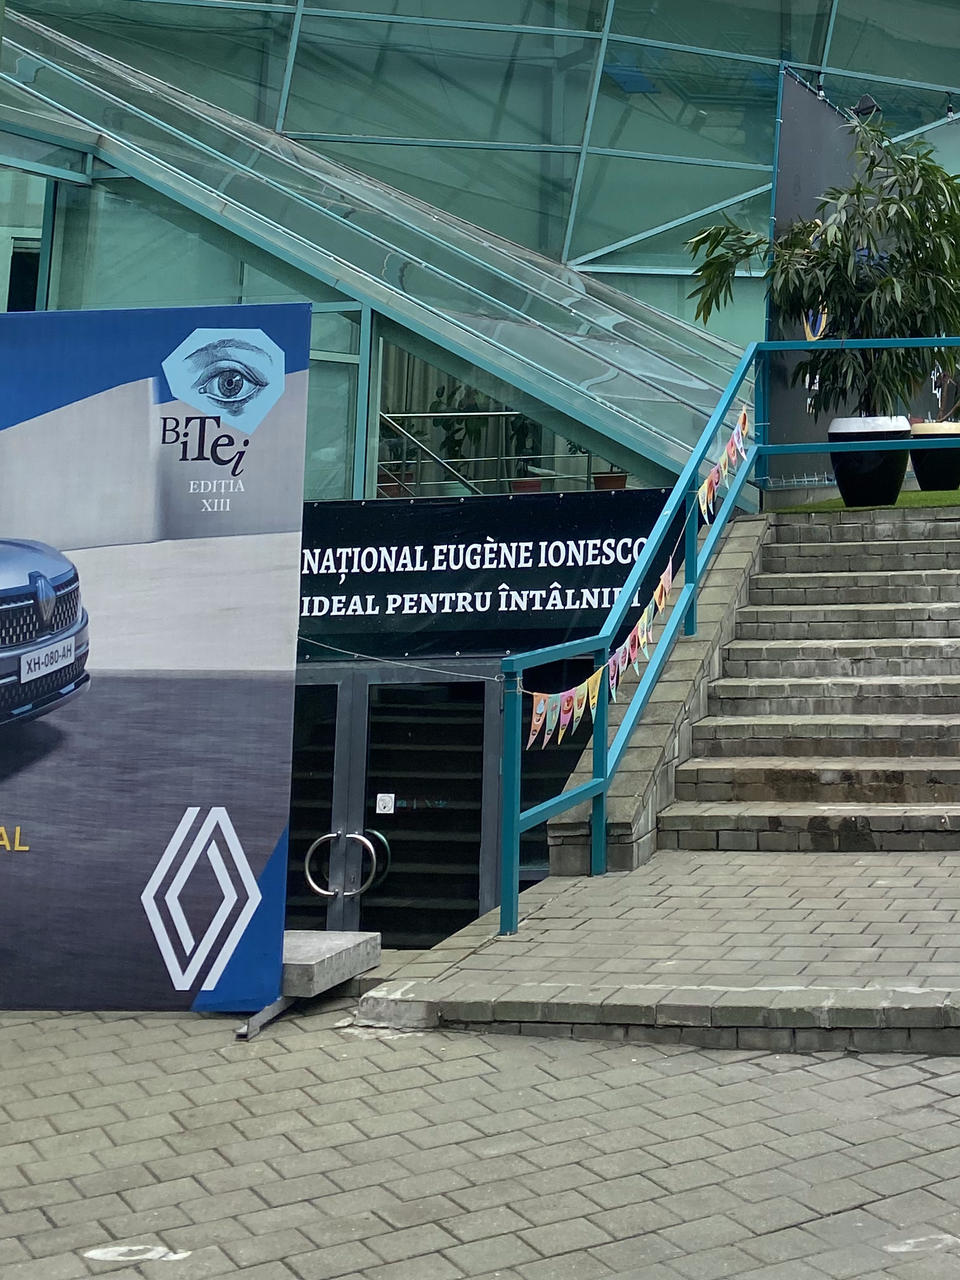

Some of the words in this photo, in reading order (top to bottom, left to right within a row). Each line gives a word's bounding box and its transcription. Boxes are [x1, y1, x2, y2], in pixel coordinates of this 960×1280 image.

[200, 498, 231, 512] XIII
[301, 544, 429, 586] NAȚIONAL
[432, 535, 534, 571] EUGÈNE
[300, 594, 380, 617] IDEAL
[385, 590, 493, 616] PENTRU
